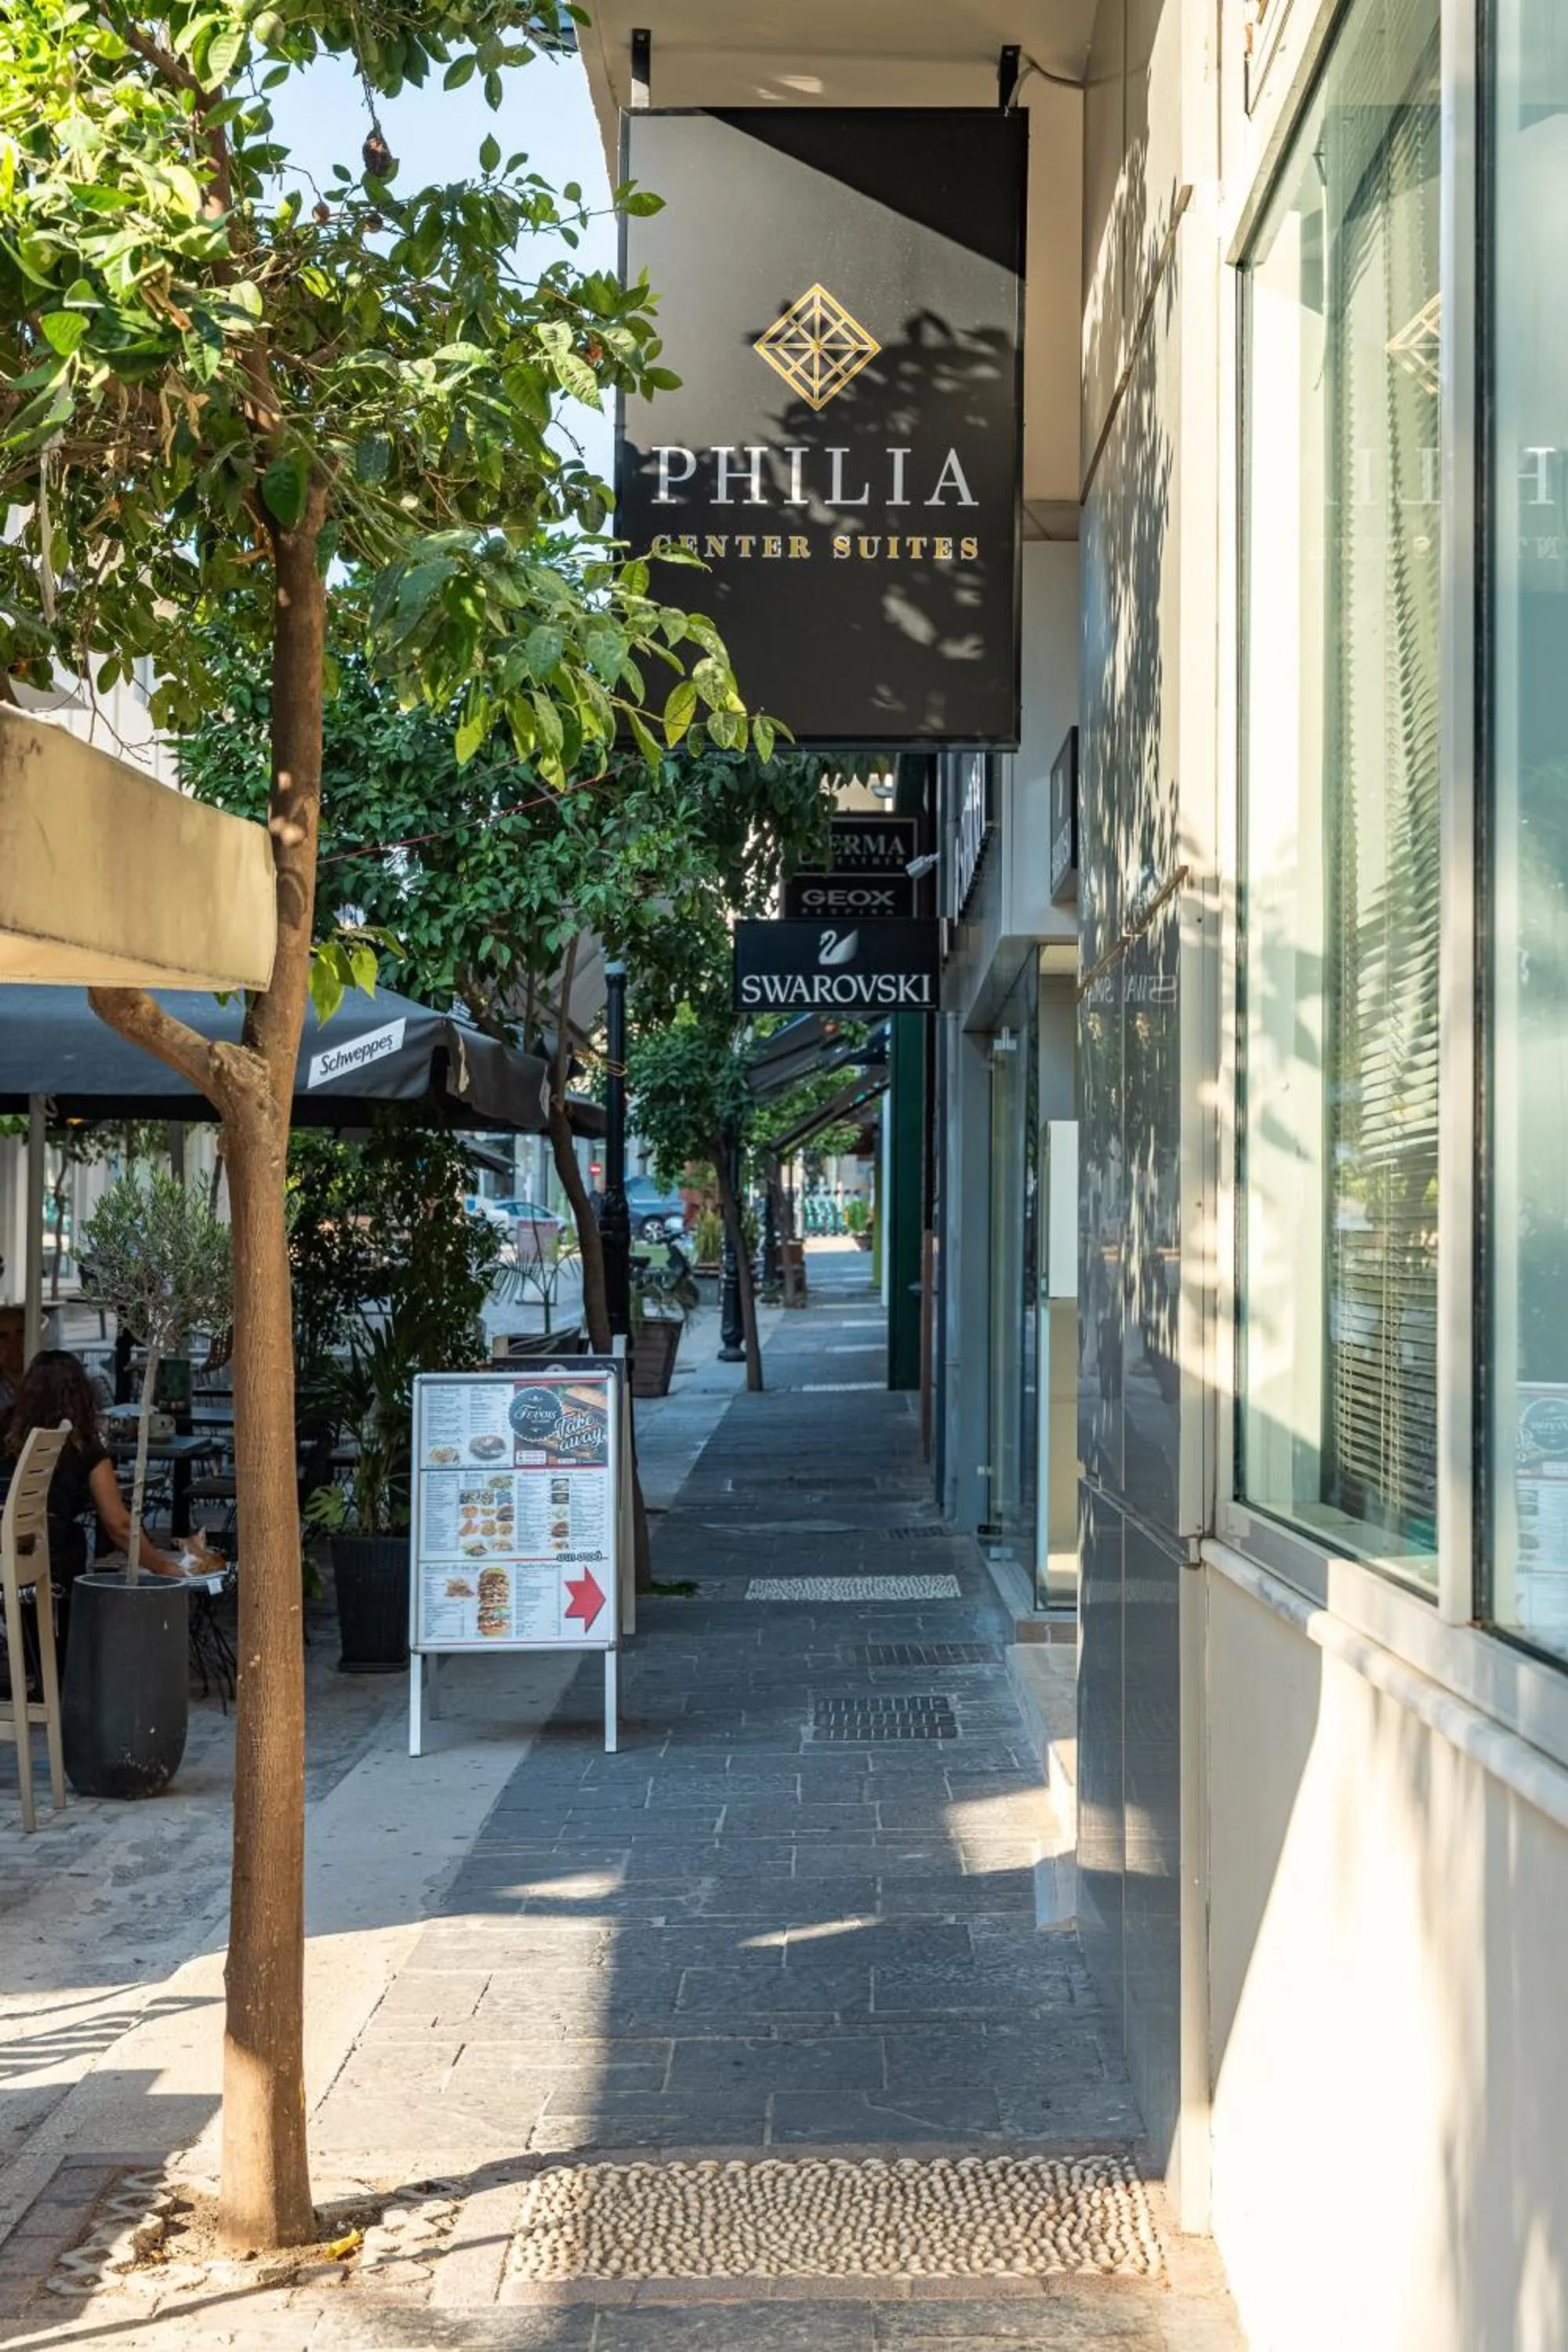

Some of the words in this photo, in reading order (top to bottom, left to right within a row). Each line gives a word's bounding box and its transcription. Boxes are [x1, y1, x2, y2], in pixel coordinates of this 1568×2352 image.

[651, 445, 979, 506] PHILIA
[652, 535, 811, 559] CENTER
[833, 535, 978, 560] SUITES
[827, 833, 906, 855] ERMA
[801, 889, 895, 906] GEOX
[742, 975, 931, 1004] SWAROVSKI
[319, 1034, 394, 1076] Schweppes
[554, 1411, 594, 1436] Take
